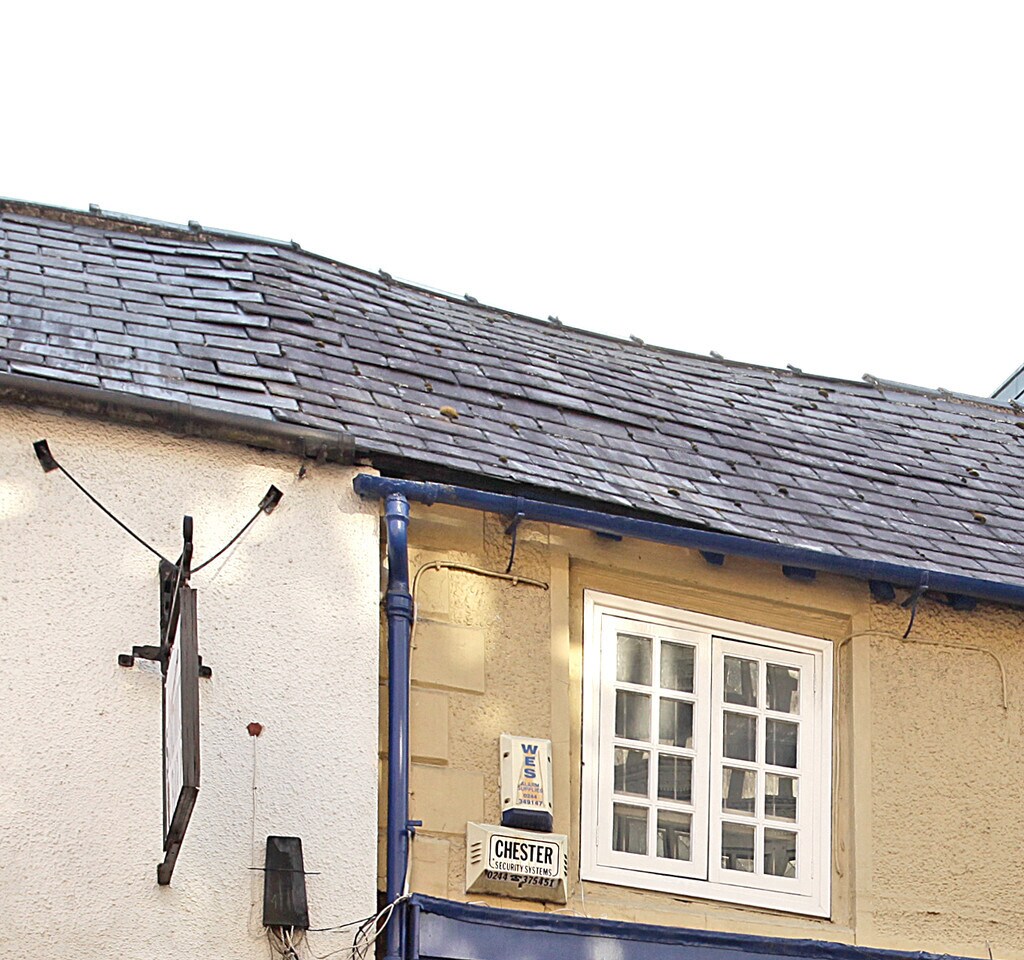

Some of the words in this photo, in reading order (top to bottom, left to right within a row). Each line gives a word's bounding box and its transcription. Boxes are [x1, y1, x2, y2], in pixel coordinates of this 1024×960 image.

[521, 743, 538, 779] WES
[495, 839, 553, 864] CHESTER
[487, 870, 508, 880] 0244
[495, 861, 523, 872] SECURITY
[525, 865, 552, 877] SYSTEMS
